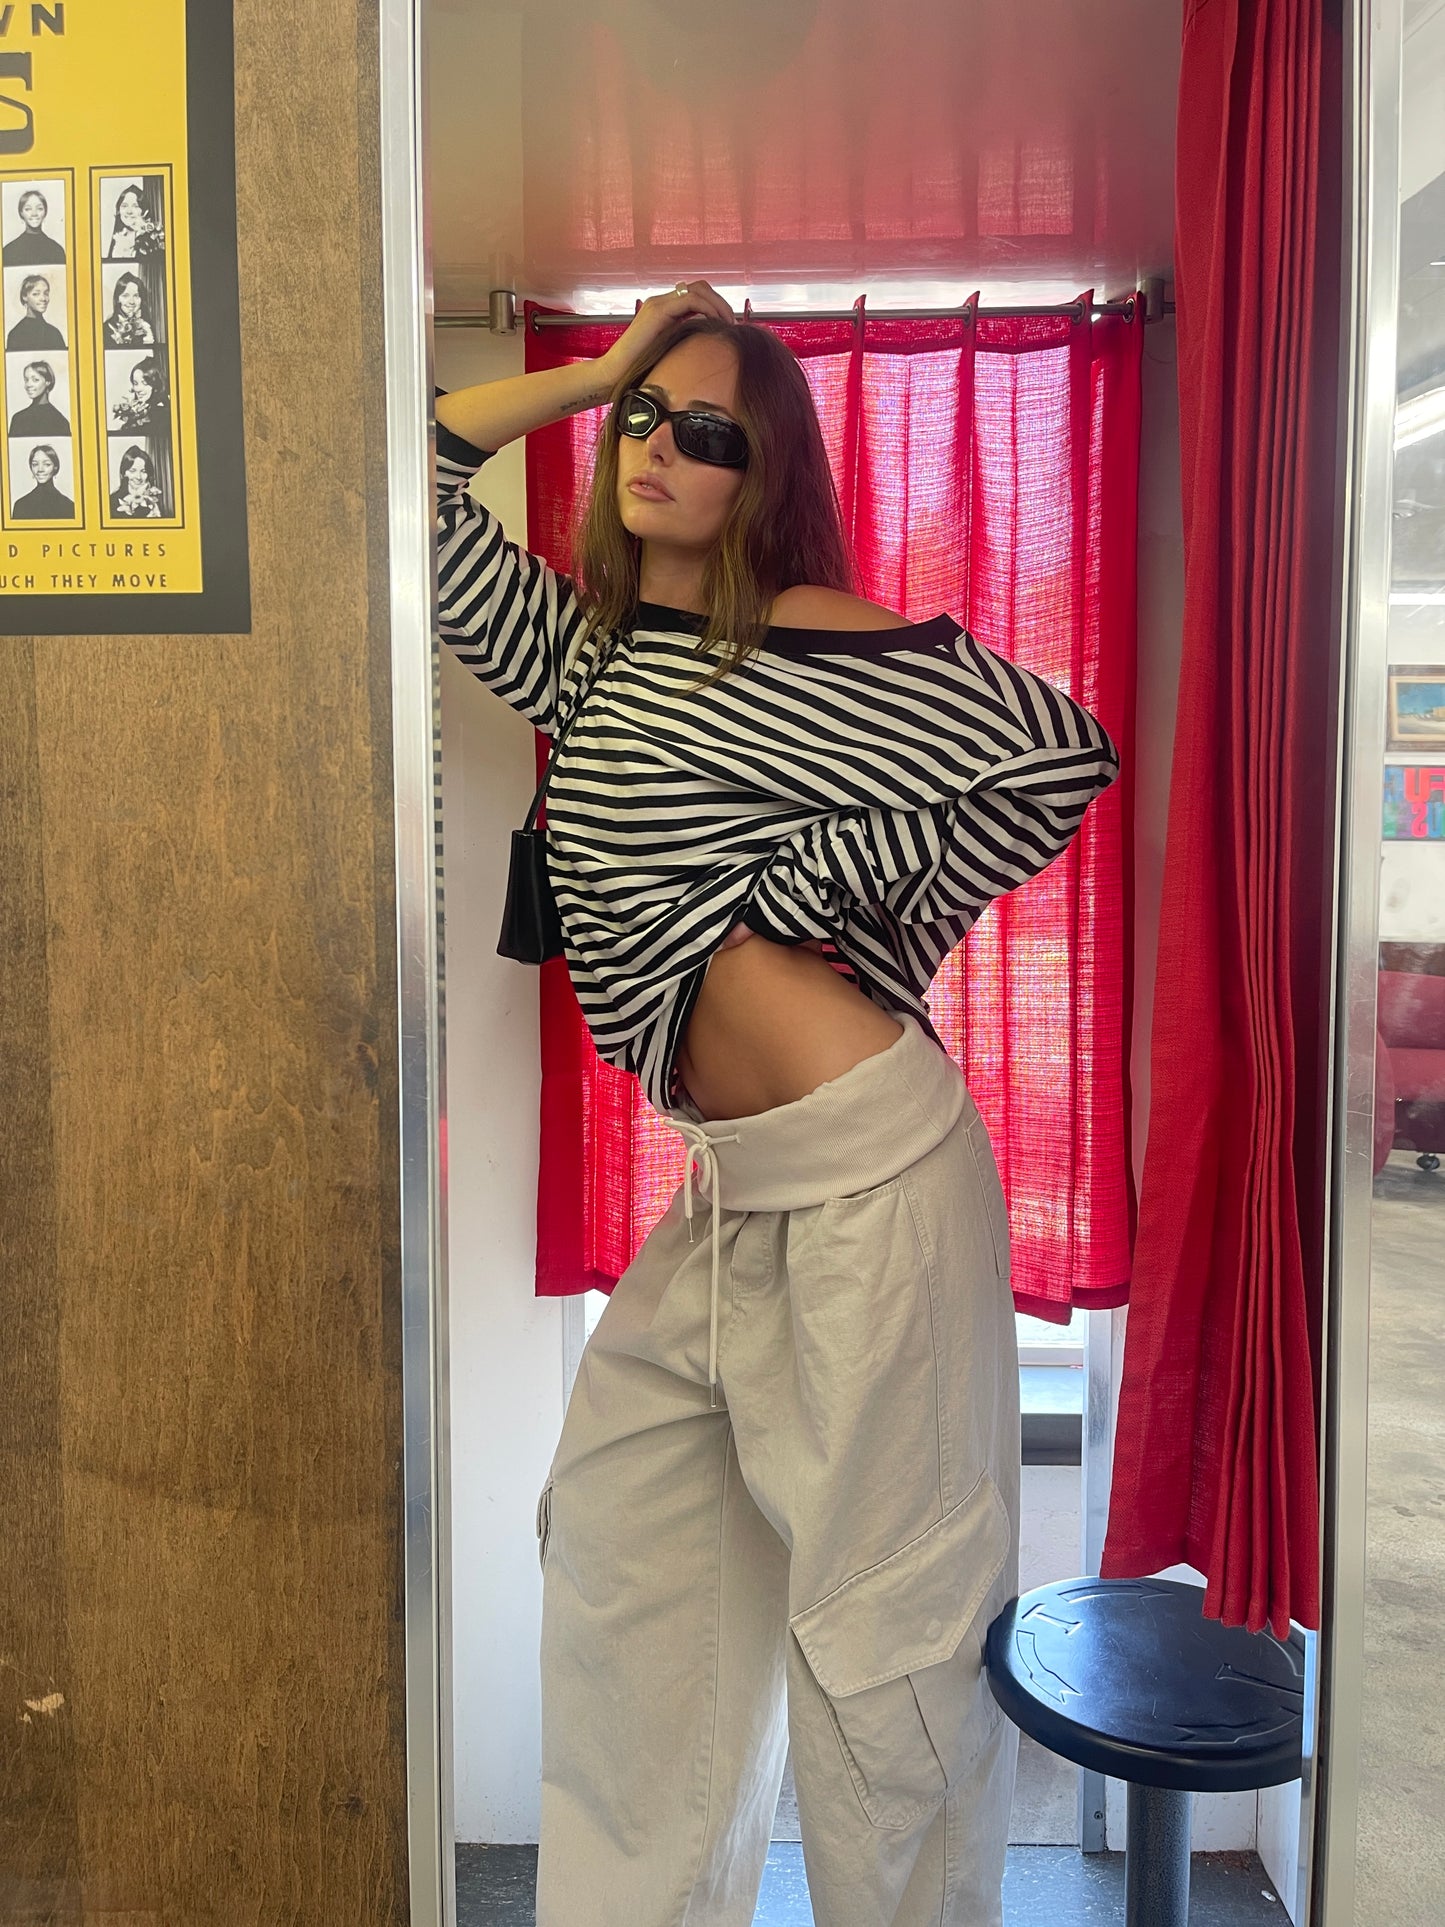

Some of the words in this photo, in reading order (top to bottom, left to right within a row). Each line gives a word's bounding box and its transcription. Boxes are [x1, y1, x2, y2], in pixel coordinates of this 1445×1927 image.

[42, 543, 167, 558] PICTURES
[50, 574, 98, 588] THEY
[112, 573, 168, 588] MOVE
